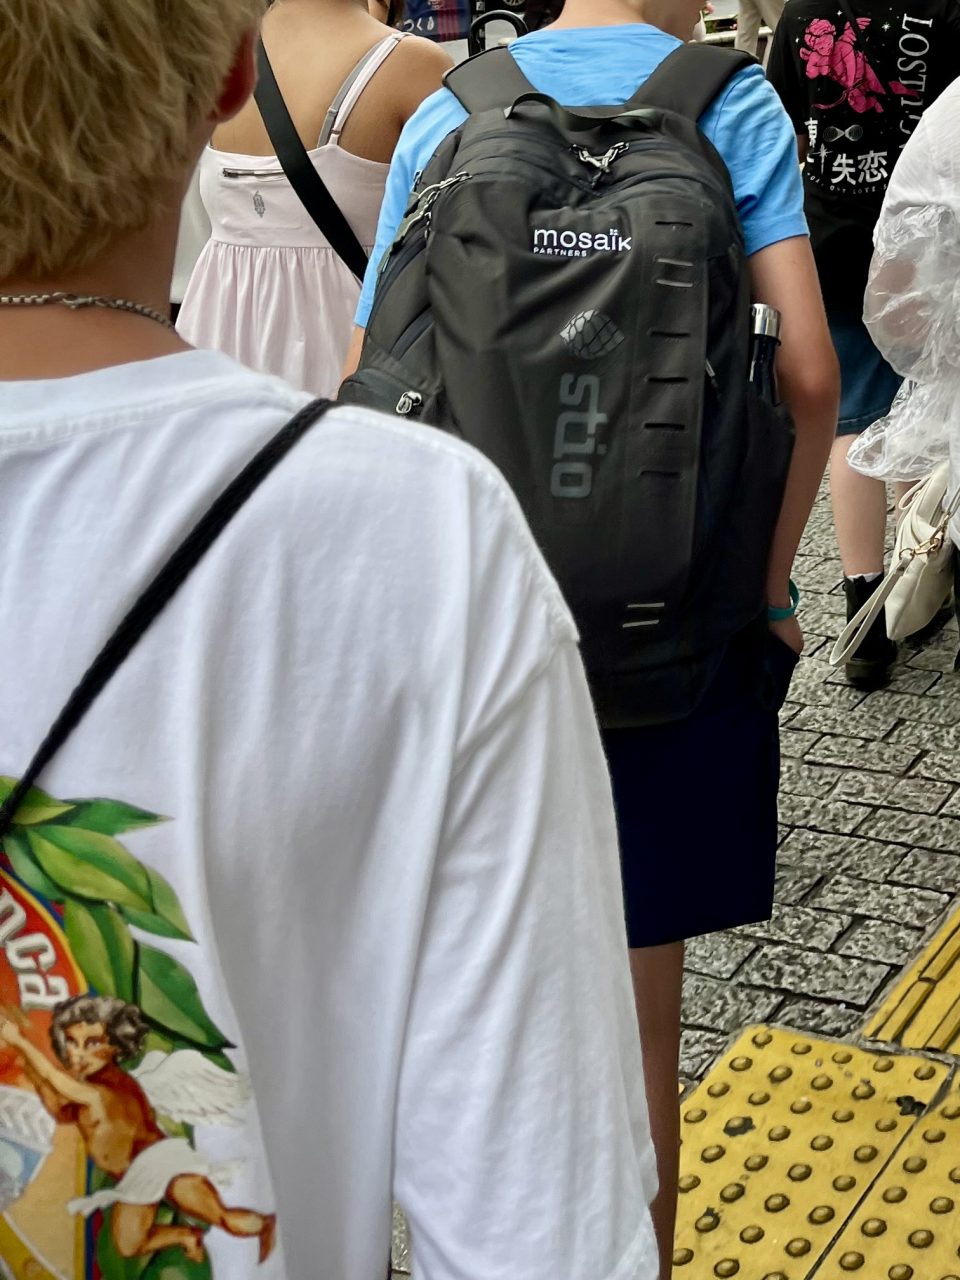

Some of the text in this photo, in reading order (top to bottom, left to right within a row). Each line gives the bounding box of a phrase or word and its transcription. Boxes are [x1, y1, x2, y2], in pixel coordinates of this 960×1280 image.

[897, 13, 933, 92] LOST
[831, 150, 888, 186] 失恋
[533, 228, 632, 252] mosaïk
[533, 246, 588, 258] PARTNERS
